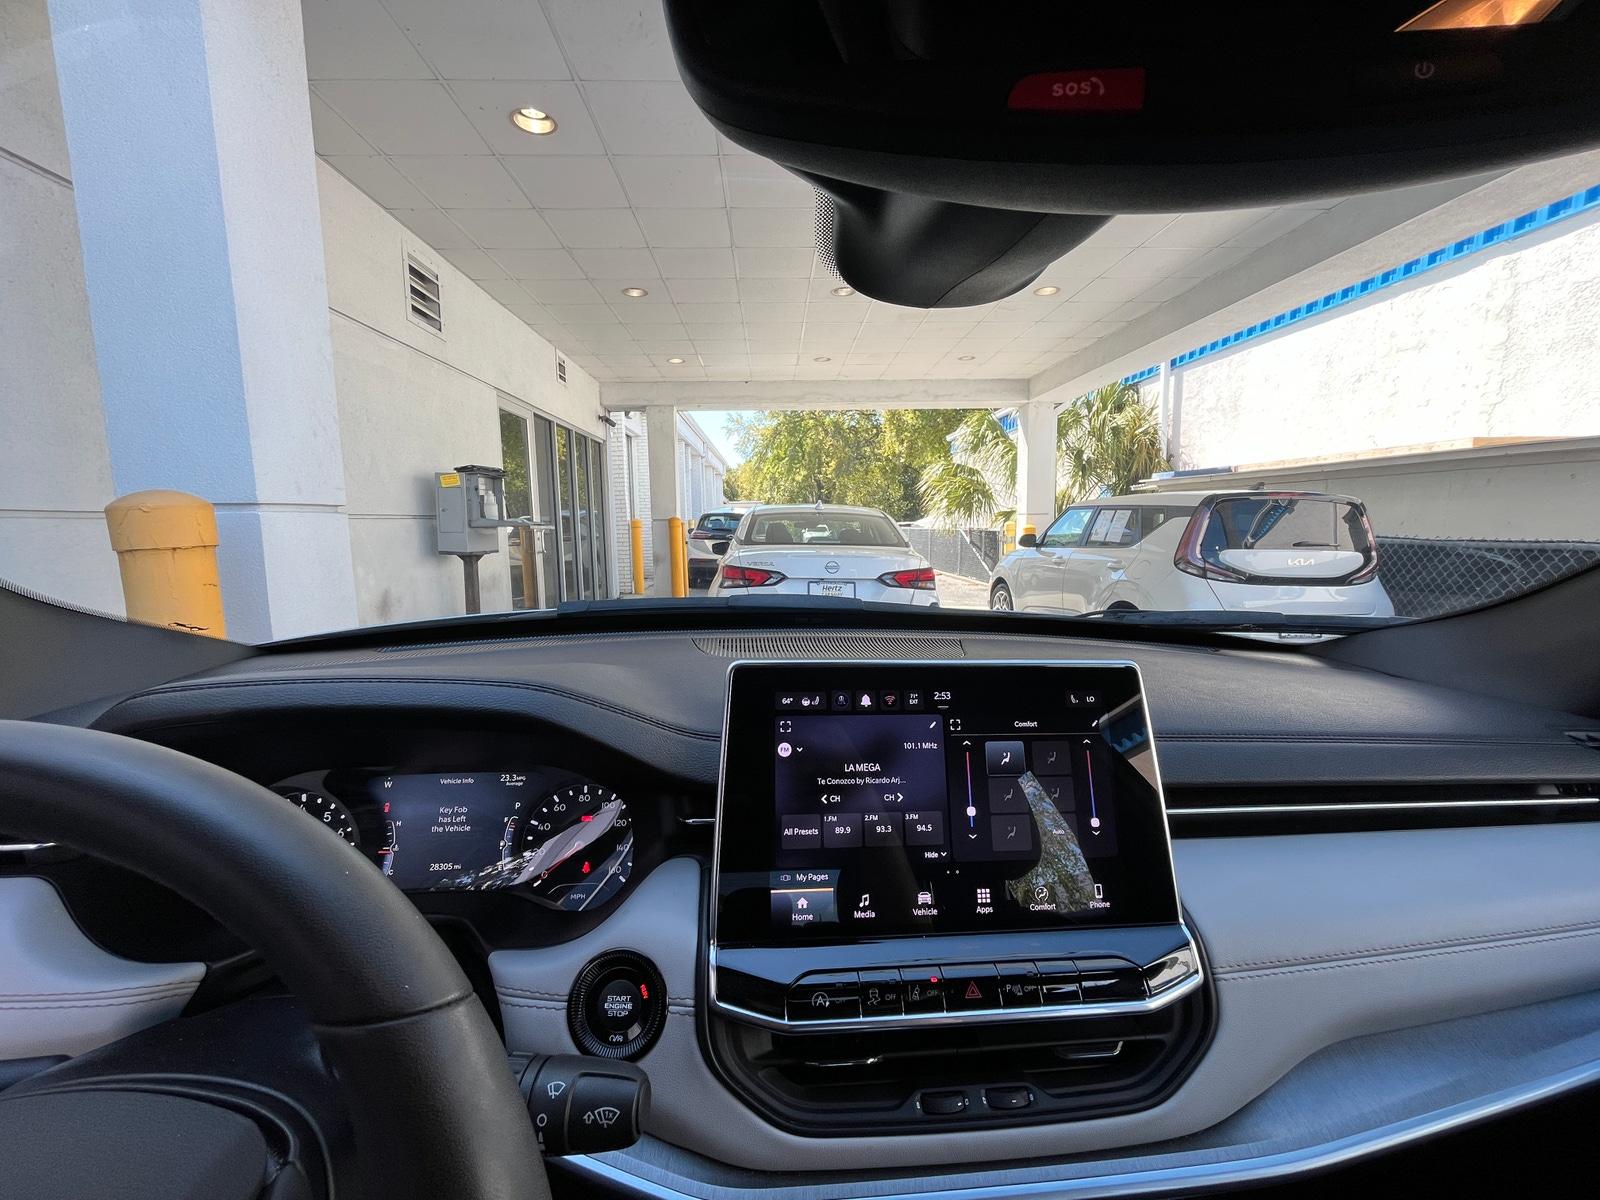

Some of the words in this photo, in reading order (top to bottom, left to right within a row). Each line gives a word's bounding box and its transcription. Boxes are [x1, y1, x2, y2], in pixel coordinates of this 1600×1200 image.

[1051, 81, 1091, 96] SOS
[934, 691, 951, 700] 2:53
[903, 742, 921, 750] 101.1
[844, 764, 855, 772] LA
[855, 763, 881, 772] MEGA
[856, 777, 865, 786] by
[578, 794, 591, 802] 80
[829, 795, 841, 803] CH
[553, 803, 566, 812] 60
[323, 811, 332, 822] 5
[537, 823, 551, 831] 40
[613, 819, 627, 827] 120
[783, 828, 794, 836] All
[794, 828, 819, 836] Presets
[835, 826, 851, 834] 89.9
[876, 825, 892, 833] 93.3
[916, 824, 933, 832] 94.5
[429, 863, 453, 871] 28305
[796, 874, 807, 882] My
[808, 873, 829, 882] Pages
[976, 906, 994, 914] Apps
[1029, 903, 1056, 911] Comfort
[854, 910, 876, 918] Media
[912, 908, 938, 916] Vehicle
[792, 913, 814, 921] Home
[926, 989, 938, 997] OFF
[604, 1002, 633, 1010] ENGINE
